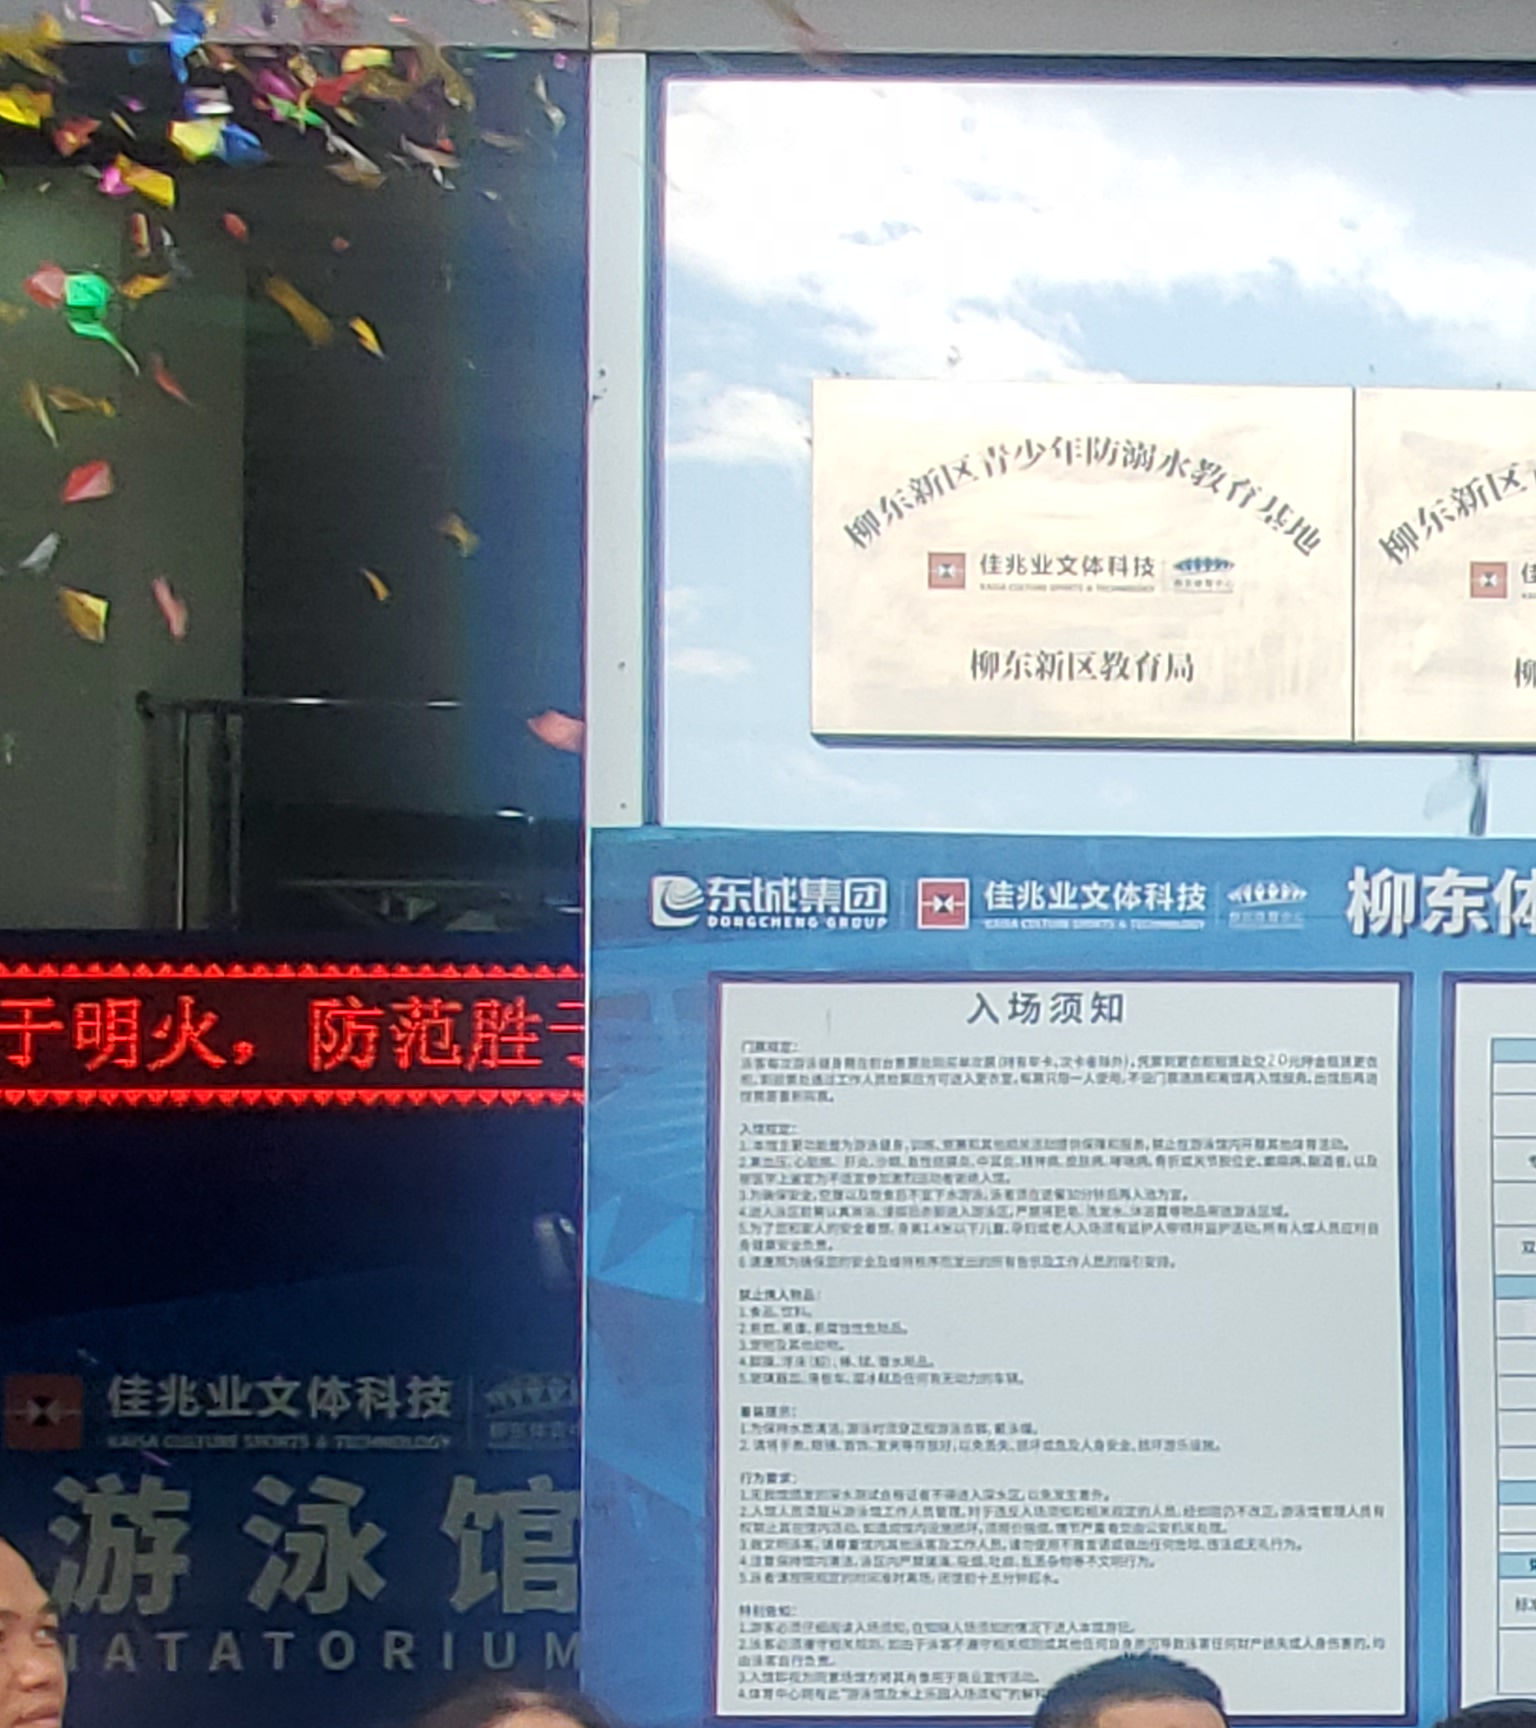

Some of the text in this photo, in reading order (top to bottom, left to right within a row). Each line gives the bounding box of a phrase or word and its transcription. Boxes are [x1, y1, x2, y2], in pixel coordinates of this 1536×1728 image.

[844, 436, 1322, 557] 柳东新区青少年防溺水教育基地
[979, 554, 1156, 577] 佳兆业文体科技
[971, 649, 1195, 683] 柳东新区教育局
[706, 875, 889, 914] 东城集团
[982, 879, 1207, 913] 佳兆业文体科技
[706, 915, 888, 930] DONGCHENG GROUP
[966, 992, 1125, 1026] 入场须知
[106, 1373, 454, 1421] 佳兆业文体科技
[50, 1473, 580, 1616] 游泳馆
